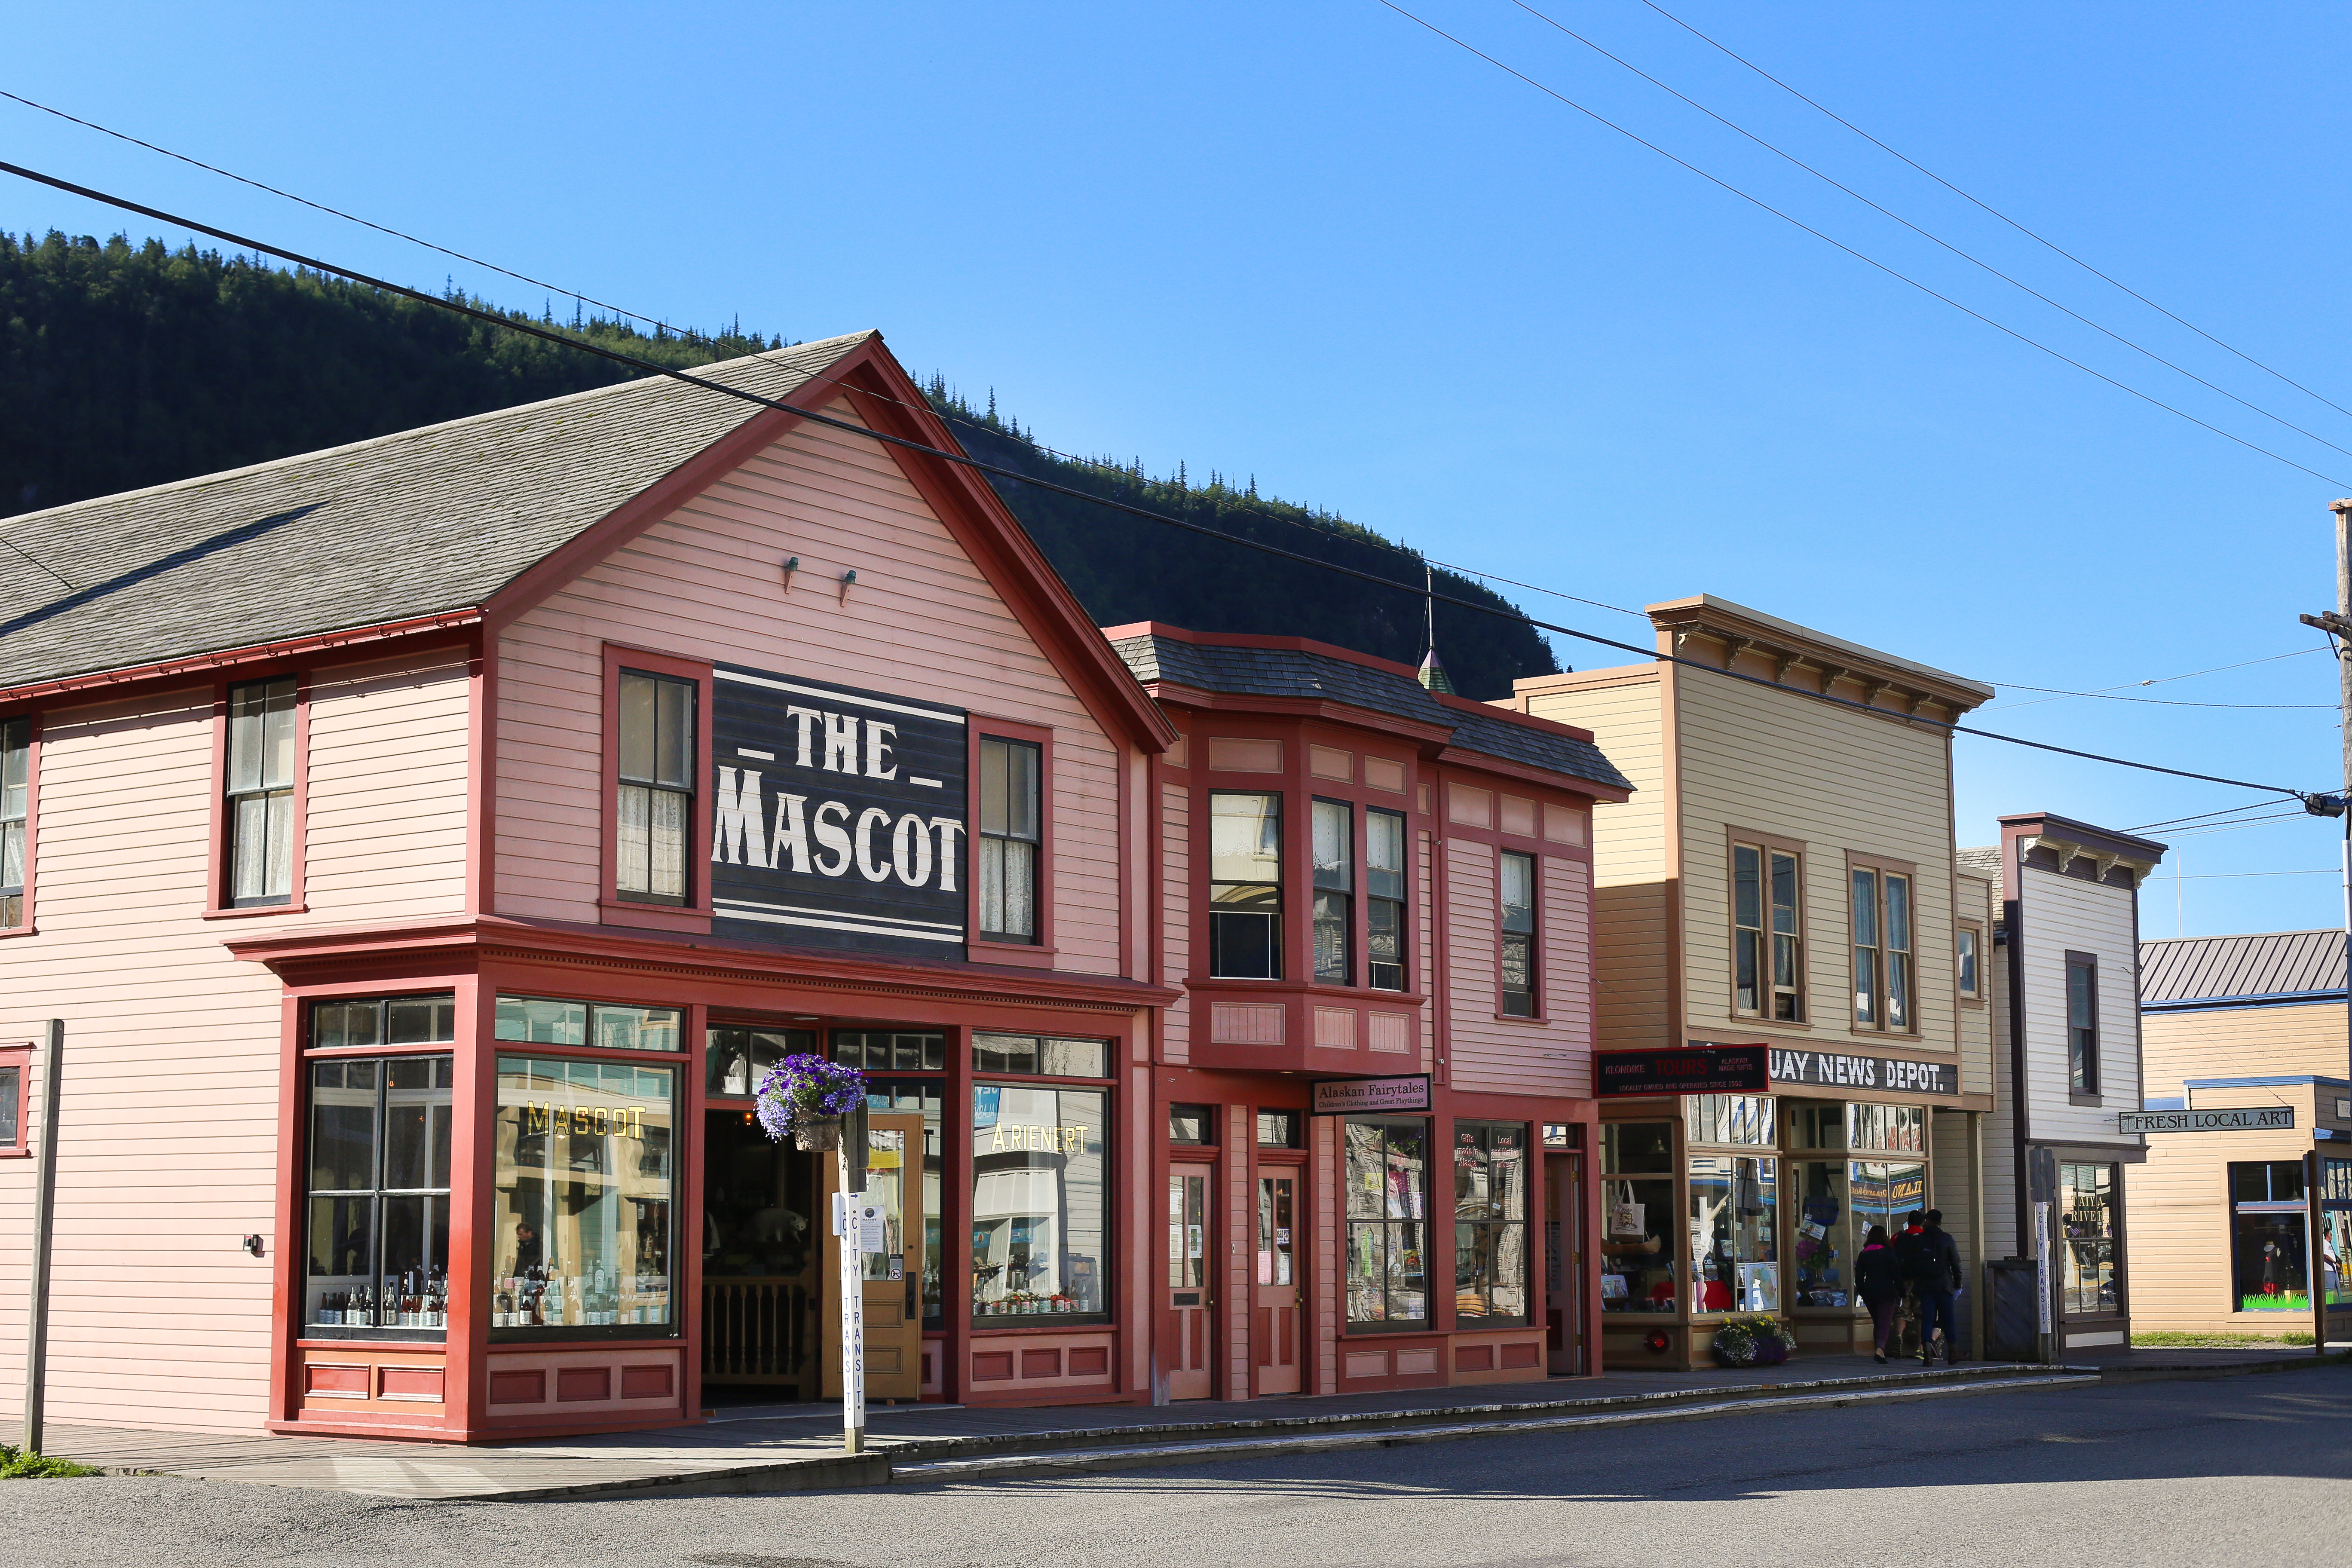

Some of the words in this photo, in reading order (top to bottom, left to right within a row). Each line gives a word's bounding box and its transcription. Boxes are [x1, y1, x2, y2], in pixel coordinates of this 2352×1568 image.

[787, 705, 897, 780] THE
[711, 765, 966, 892] MASCOT
[1605, 1065, 1645, 1075] KLONDIKE
[1654, 1059, 1707, 1075] TOURS
[1819, 1054, 1874, 1086] NEWS
[1886, 1060, 1943, 1091] DEPOT.
[1319, 1086, 1364, 1098] Alaskan
[1368, 1082, 1424, 1096] Fairytales
[527, 1100, 646, 1140] MASCOT
[2135, 1115, 2188, 1129] FRESH
[2194, 1113, 2253, 1128] LOCAL
[2257, 1110, 2291, 1126] ART
[1461, 1134, 1475, 1143] Gifts
[1498, 1135, 1512, 1145] Local
[1457, 1146, 1473, 1155] made
[1473, 1146, 1479, 1155] in
[1491, 1148, 1502, 1156] and
[1502, 1147, 1519, 1156] Native
[1459, 1158, 1477, 1167] Alaska
[1497, 1160, 1514, 1168] Artists
[2071, 1195, 2104, 1207] TAIYA
[2070, 1210, 2104, 1222] RIVER
